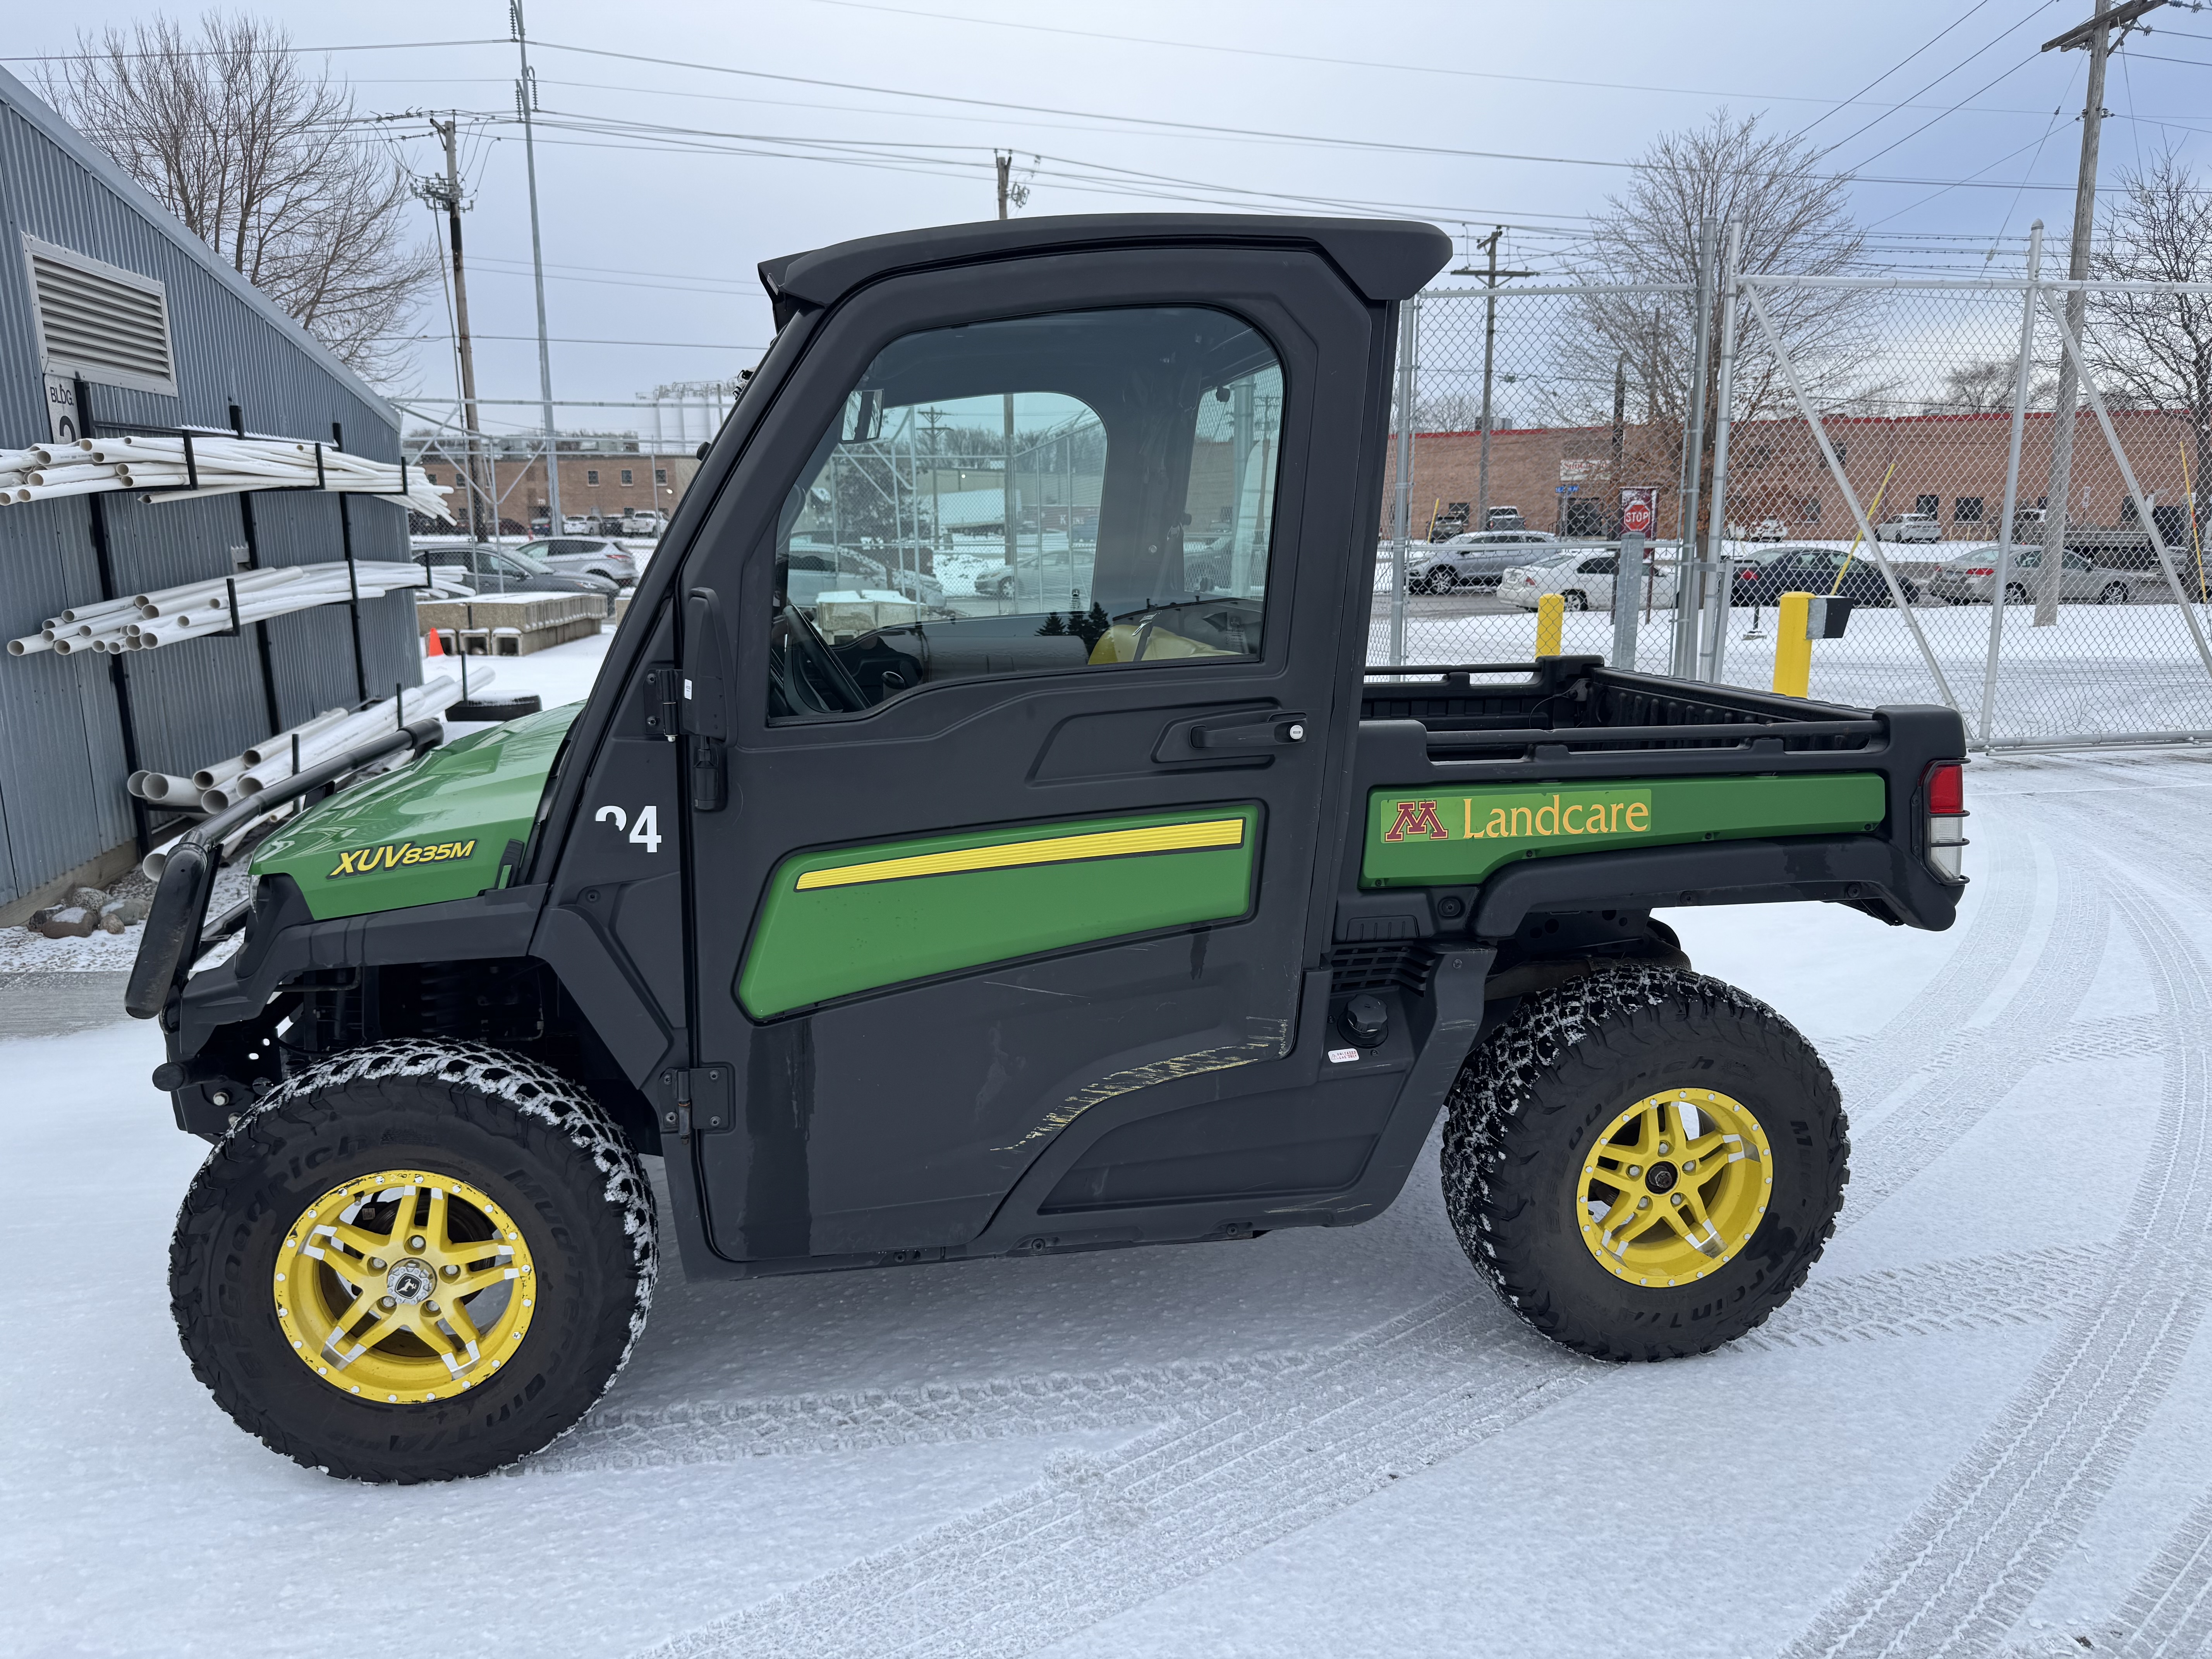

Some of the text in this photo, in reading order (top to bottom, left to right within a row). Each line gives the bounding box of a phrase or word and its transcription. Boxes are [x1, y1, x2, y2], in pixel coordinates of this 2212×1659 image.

[50, 386, 74, 406] BLDG.
[1625, 512, 1649, 523] STOP
[1384, 794, 1649, 842] M Landcare
[330, 840, 475, 876] XUV835M
[219, 1135, 368, 1379] BFGoodrich
[486, 1169, 584, 1427] Mud-Terrain
